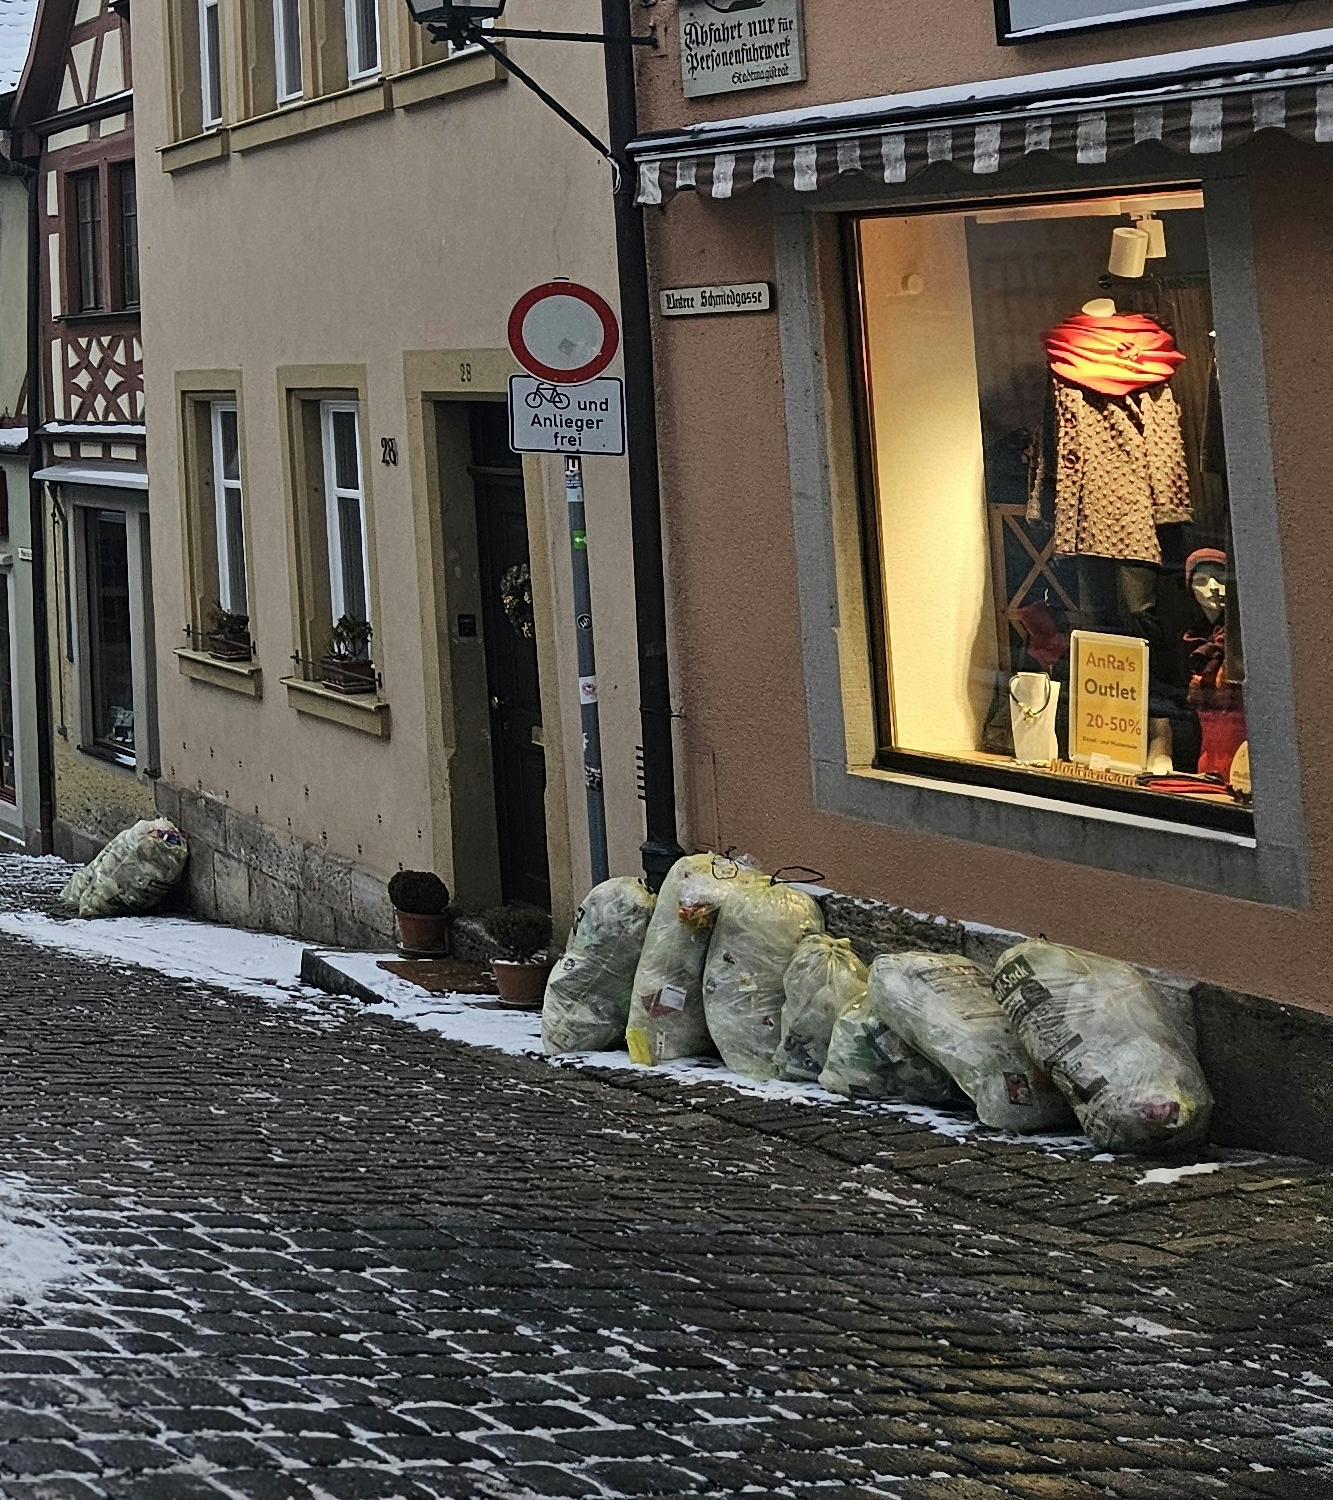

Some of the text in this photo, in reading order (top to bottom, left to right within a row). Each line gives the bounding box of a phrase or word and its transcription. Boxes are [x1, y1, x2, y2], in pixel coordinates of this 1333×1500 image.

[684, 16, 794, 52] Abfahrt nur für
[665, 289, 763, 310] Untere Schmiedgasse
[459, 363, 472, 382] 28
[577, 397, 609, 412] und
[530, 413, 604, 432] Anlieger
[553, 431, 582, 447] frei
[381, 437, 398, 466] 28
[1086, 651, 1136, 673] AnRa's
[1084, 677, 1137, 701] Outlet
[1086, 712, 1142, 736] 20-50%
